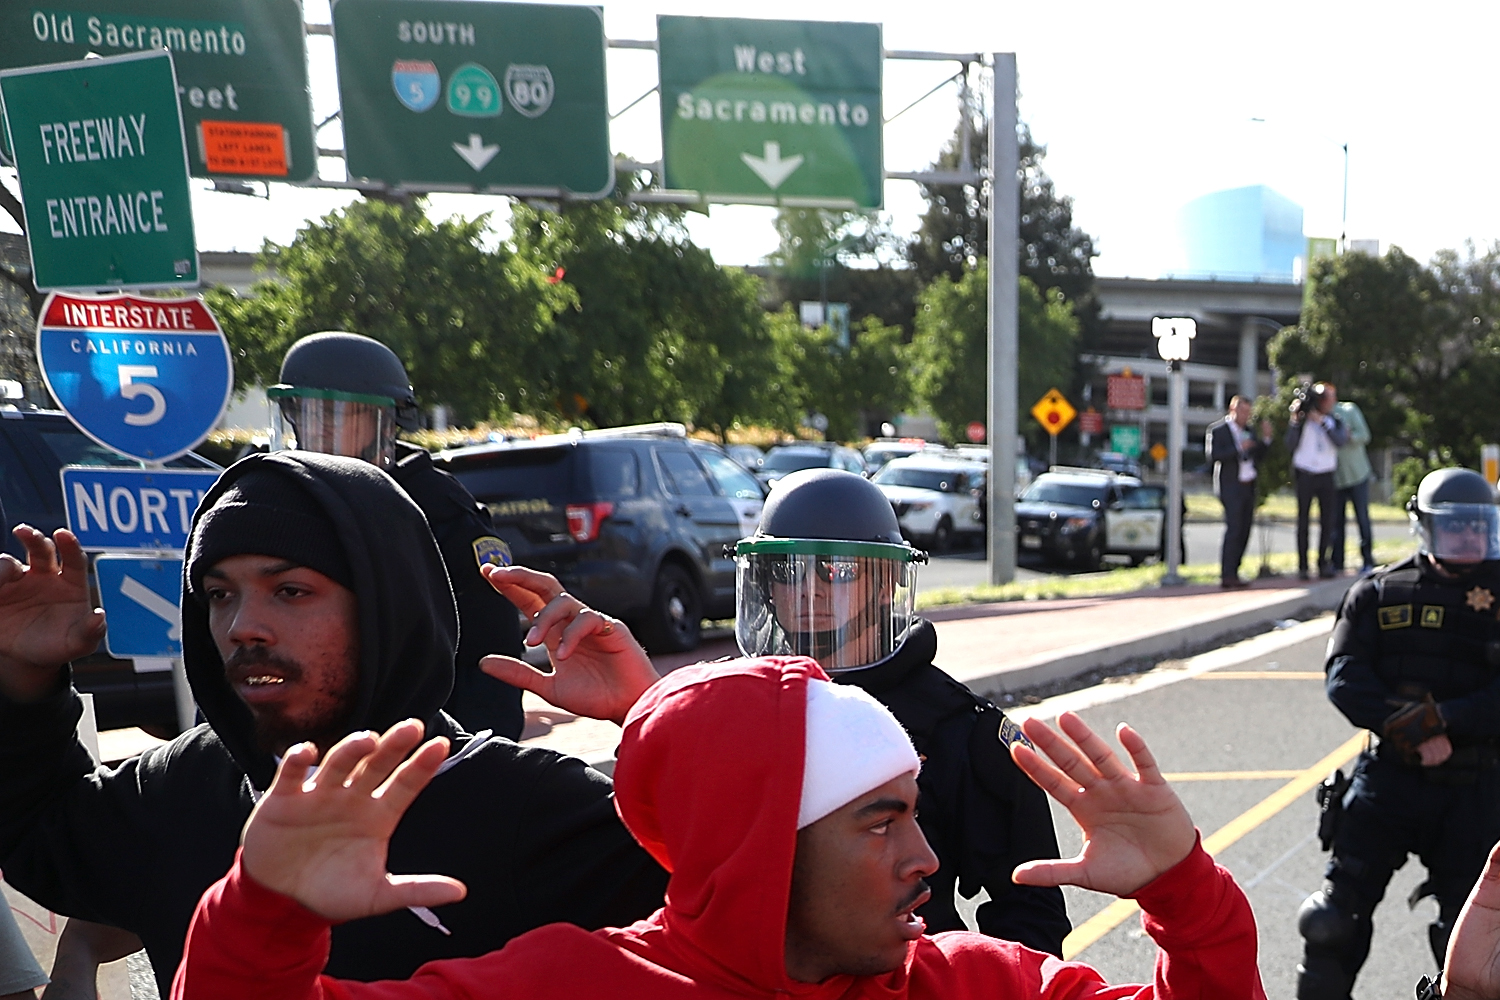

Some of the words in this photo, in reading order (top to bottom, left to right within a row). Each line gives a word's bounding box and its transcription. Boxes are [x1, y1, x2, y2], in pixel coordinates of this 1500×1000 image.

[32, 11, 75, 44] Old
[87, 18, 245, 55] Sacramento
[398, 20, 476, 46] SOUTH
[733, 45, 806, 76] West
[408, 81, 425, 103] 5
[513, 80, 548, 106] 80
[676, 93, 870, 127] Sacramento
[40, 113, 146, 165] FREEWAY
[47, 191, 168, 239] ENTRANCE
[64, 302, 195, 330] INTERSTATE
[70, 338, 198, 357] CALIFORNIA
[118, 364, 167, 427] 5
